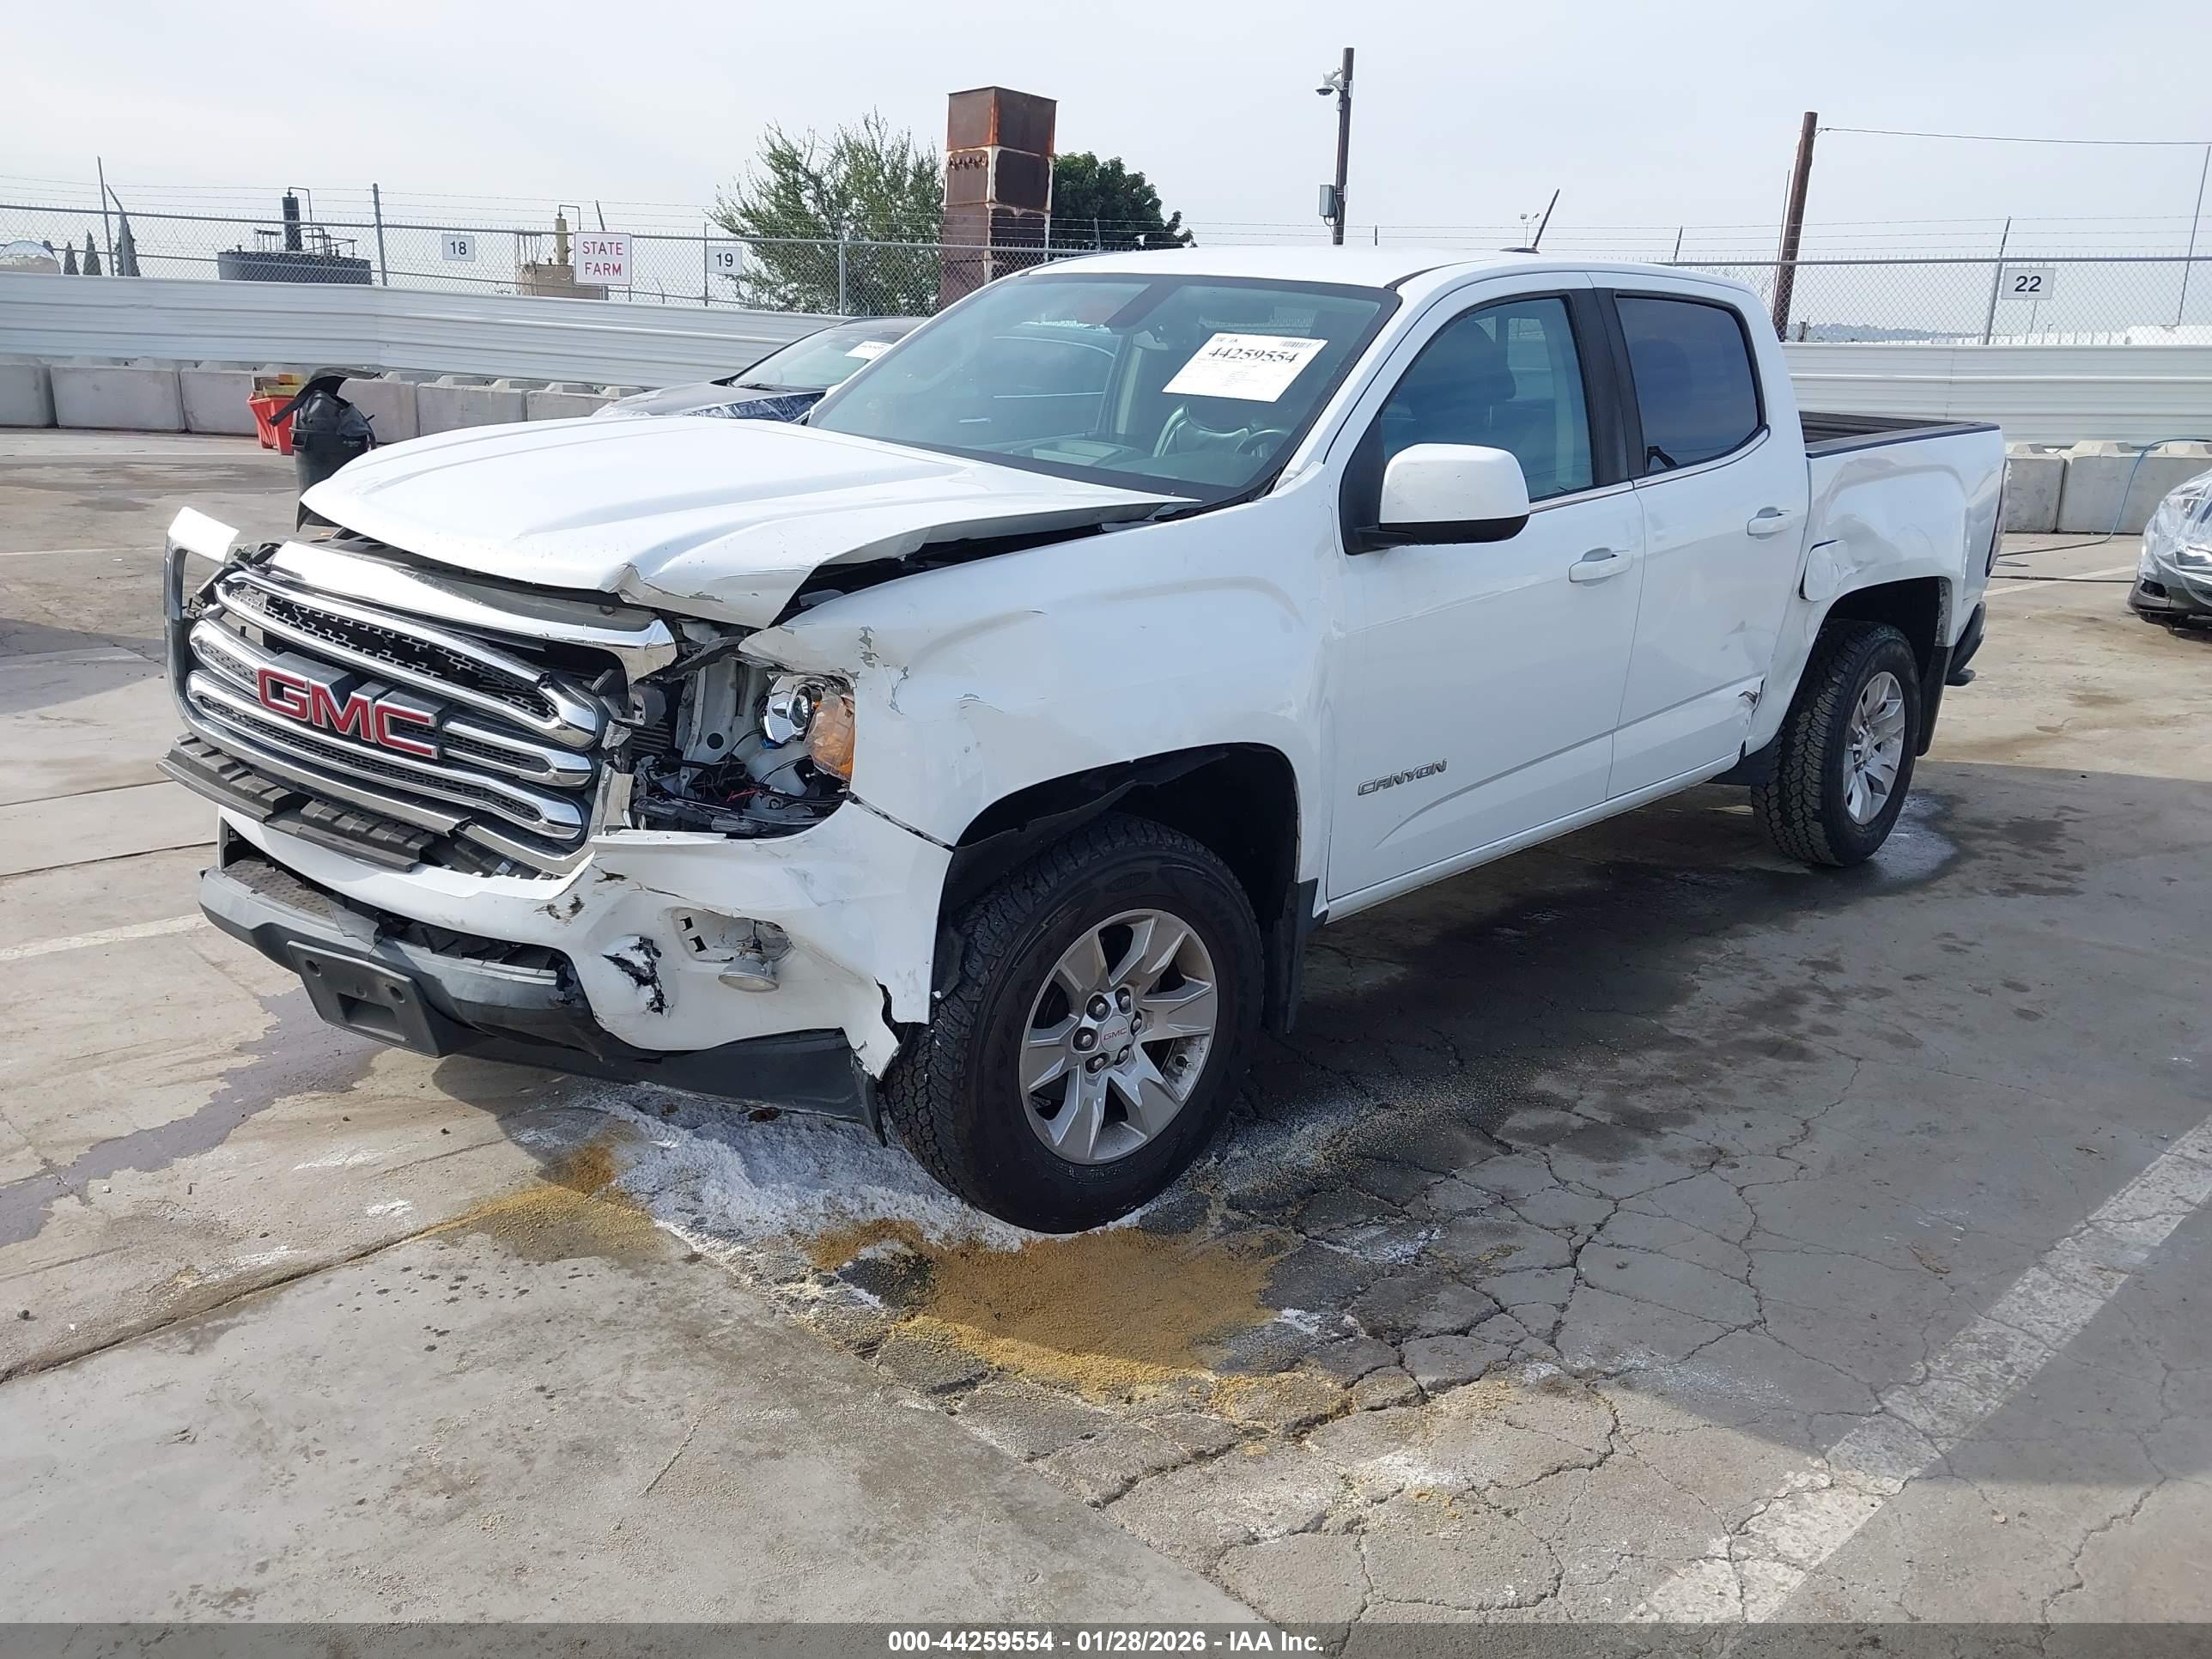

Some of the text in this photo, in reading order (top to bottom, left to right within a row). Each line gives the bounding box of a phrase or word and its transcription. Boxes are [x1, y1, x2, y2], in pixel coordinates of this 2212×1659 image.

[450, 241, 467, 256] 18
[582, 241, 624, 256] STATE
[715, 252, 733, 267] 19
[585, 262, 622, 276] FARM
[2014, 276, 2041, 292] 22
[1208, 347, 1299, 363] 44259554
[258, 666, 440, 760] GMC
[1358, 758, 1448, 796] CANYON
[1103, 1026, 1127, 1041] GMC
